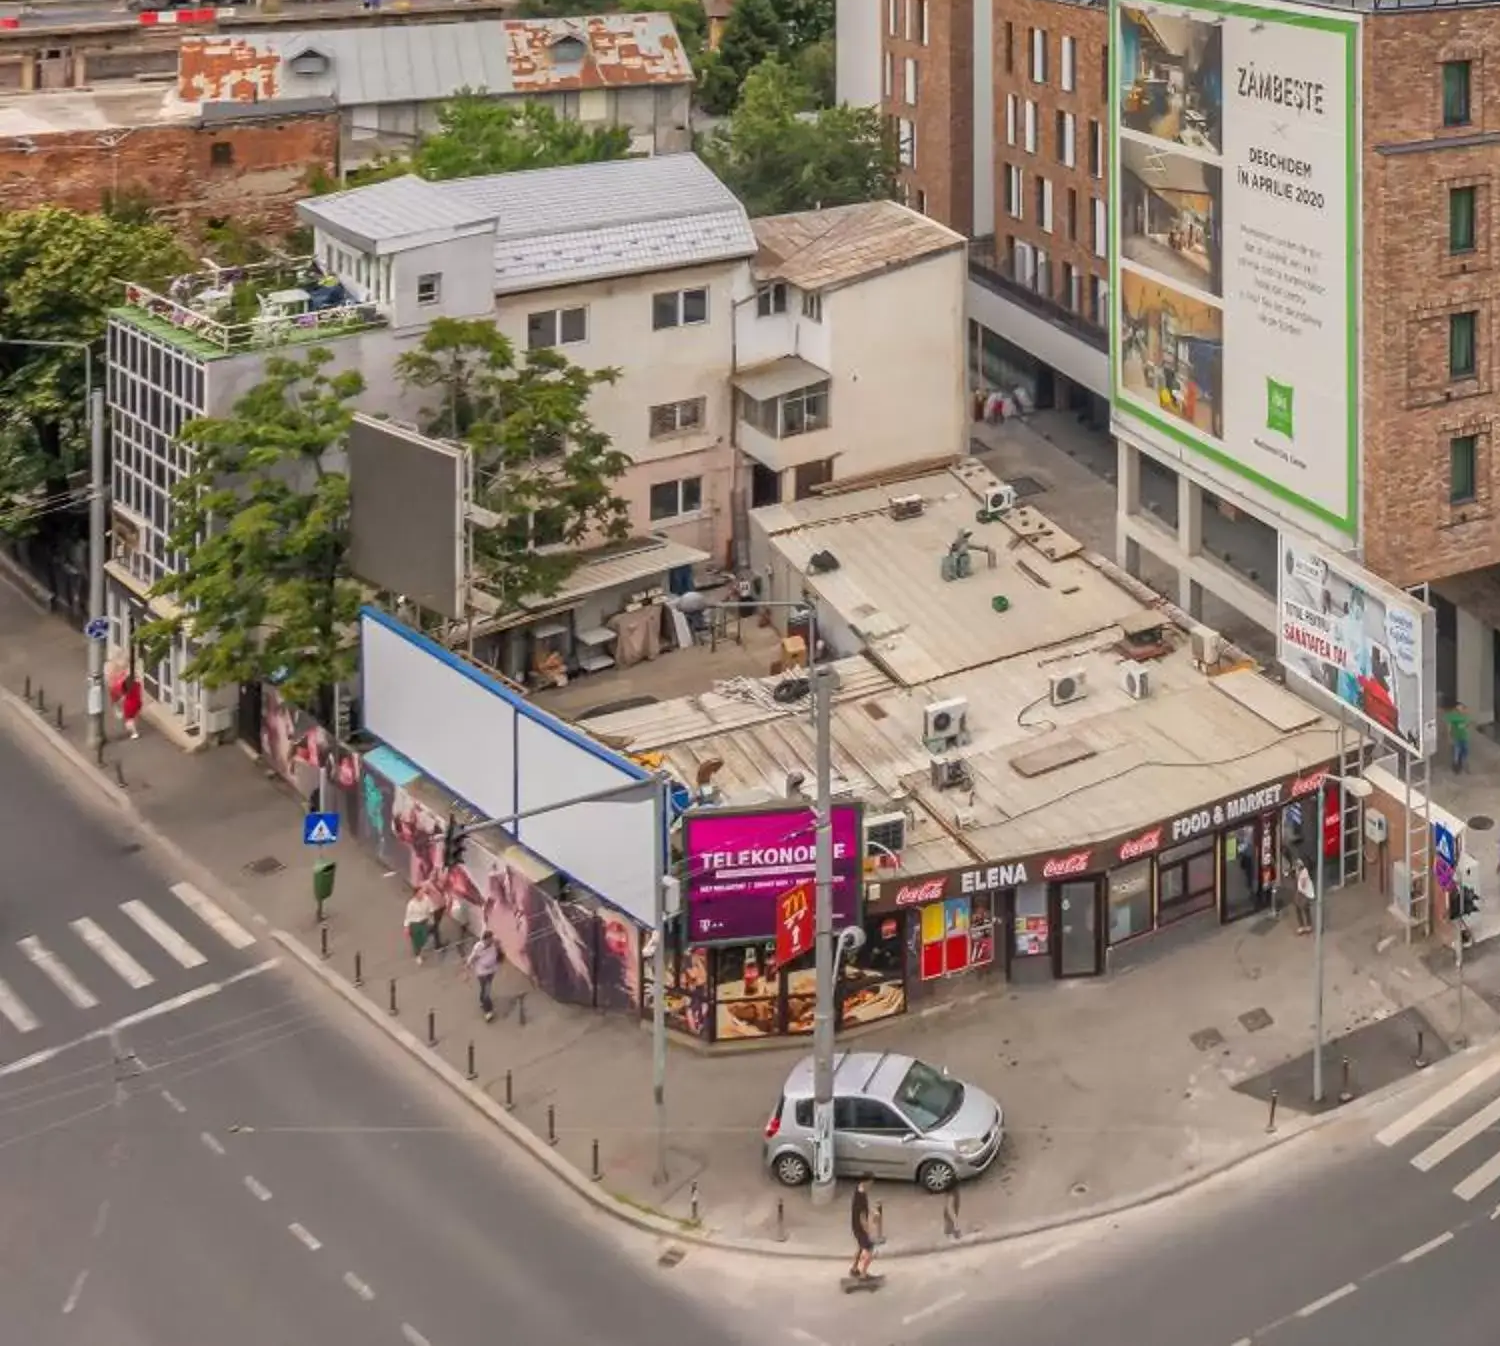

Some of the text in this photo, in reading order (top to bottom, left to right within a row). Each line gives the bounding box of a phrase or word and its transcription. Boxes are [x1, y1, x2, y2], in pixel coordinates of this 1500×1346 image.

[1249, 147, 1312, 178] DESCHIDEM
[1251, 174, 1293, 199] APRILIE
[1295, 186, 1325, 209] 2020
[1172, 784, 1283, 841] FOOD & MARKET
[700, 843, 846, 870] TELEKONOE
[961, 862, 1028, 894] ELENA
